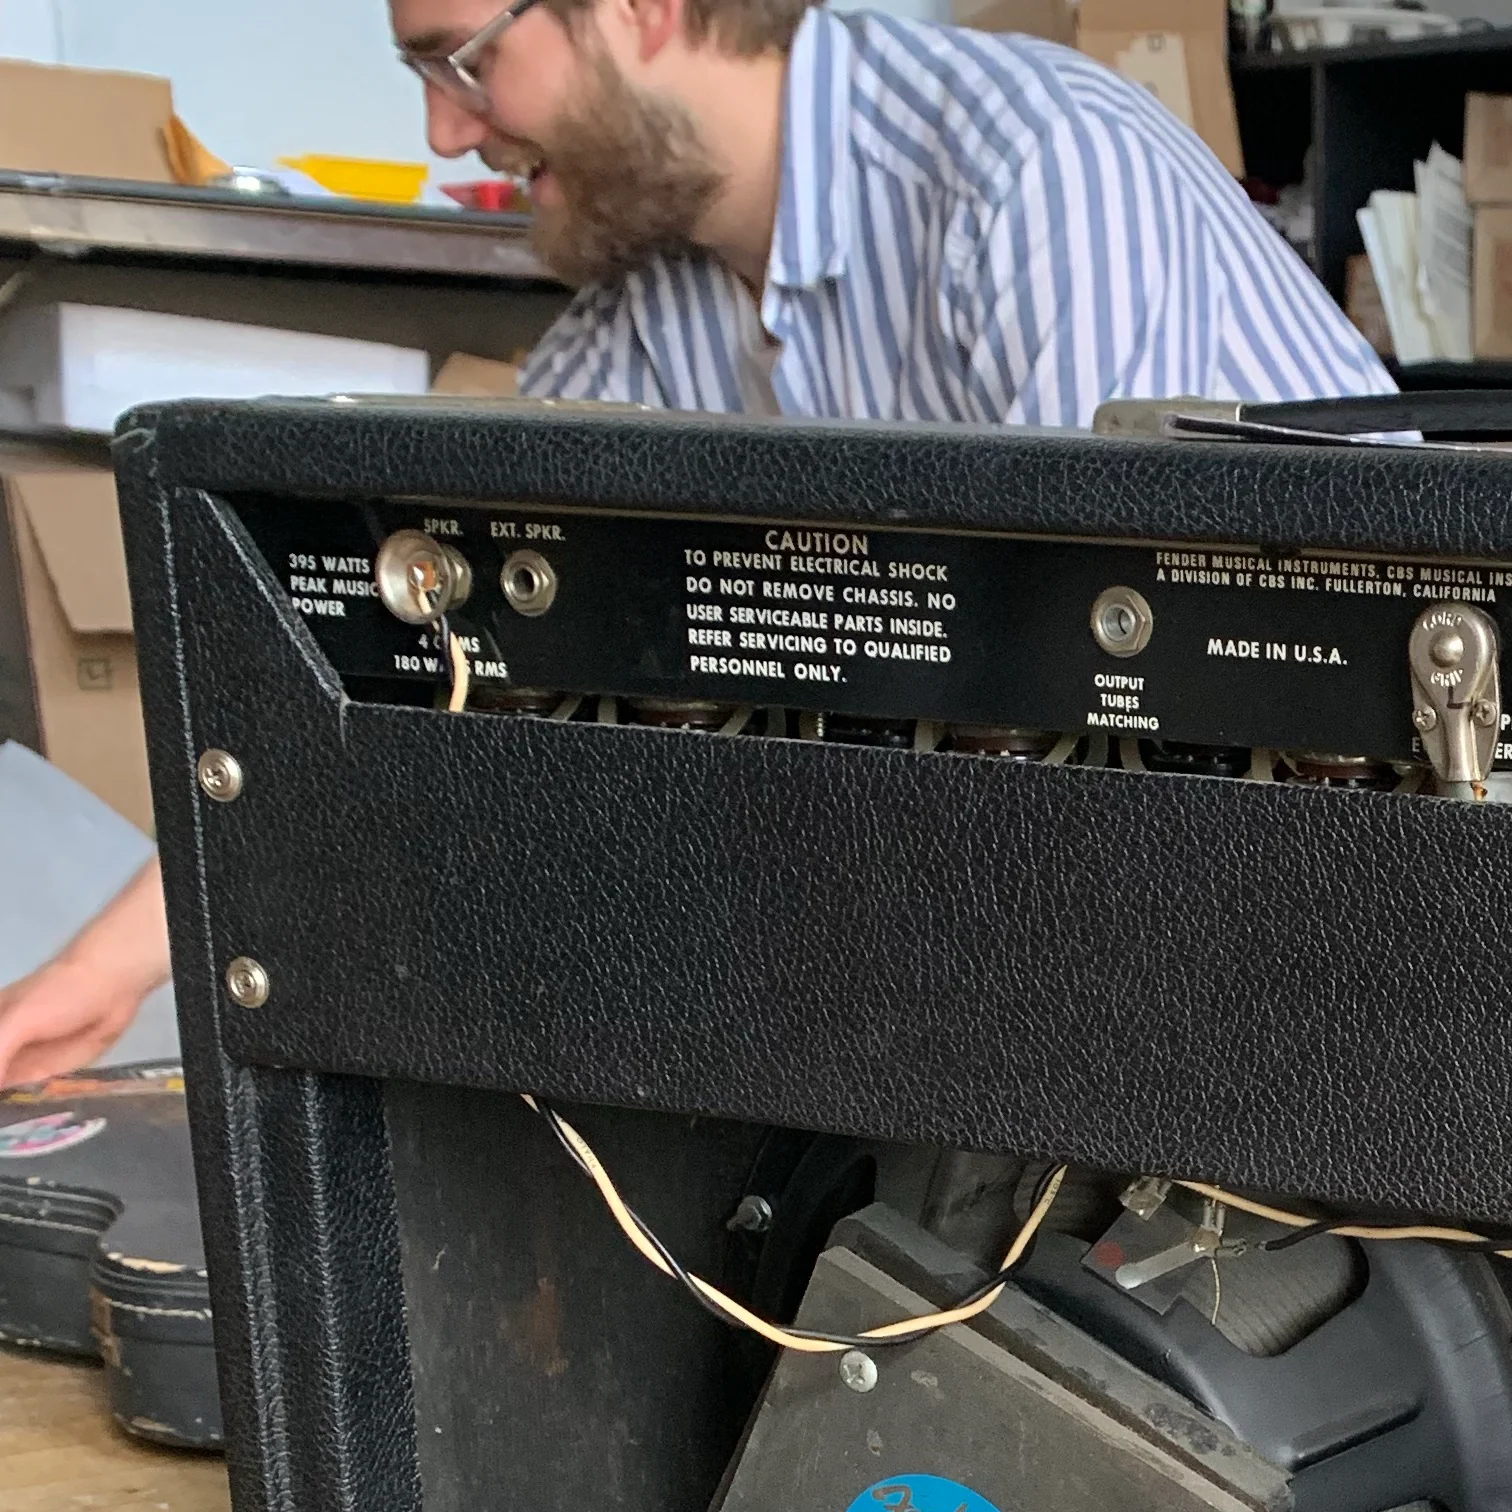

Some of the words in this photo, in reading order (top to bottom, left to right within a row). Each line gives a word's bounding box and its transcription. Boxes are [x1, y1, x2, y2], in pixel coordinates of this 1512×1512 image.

[424, 519, 464, 537] SPKR.
[491, 521, 521, 538] EXT.
[525, 523, 566, 542] SPKR.
[765, 530, 869, 556] CAUTION
[289, 554, 316, 570] 395
[321, 556, 370, 574] WATTS
[684, 549, 706, 566] TO
[714, 551, 782, 571] PREVENT
[790, 555, 880, 577] ELECTRICAL
[888, 562, 948, 582] SHOCK
[1156, 552, 1206, 568] FENDER
[1212, 554, 1272, 572] MUSICAL
[1386, 566, 1414, 581] CBS
[1420, 568, 1483, 585] MUSICAL
[290, 575, 328, 593] PEAK
[333, 579, 381, 597] MUSIC
[686, 576, 712, 594] DO
[720, 578, 754, 597] NOT
[763, 581, 834, 602] REMOVE
[842, 586, 918, 608] CHASSIS.
[928, 593, 956, 611] NO
[1156, 568, 1166, 582] A
[1171, 569, 1230, 586] DIVISION
[1236, 573, 1252, 587] OF
[1259, 575, 1285, 589] CBS
[1291, 576, 1318, 591] INC.
[1413, 583, 1496, 603] CALIFORNIA
[292, 597, 346, 617] POWER
[687, 603, 723, 621] USER
[729, 606, 828, 630] SERVICEABLE
[834, 613, 883, 633] PARTS
[890, 618, 948, 639] INSIDE.
[418, 633, 428, 650] 4
[688, 628, 732, 648] REFER
[739, 631, 827, 655] SERVICING
[834, 638, 857, 656] TO
[864, 640, 951, 663] QUALIFIED
[1207, 638, 1260, 659] MADE
[1266, 642, 1287, 661] IN
[1294, 645, 1348, 666] U.S.A.
[393, 654, 420, 672] 180
[474, 660, 508, 679] RMS
[690, 655, 785, 679] PERSONNEL
[794, 662, 848, 683] ONLY.
[1094, 673, 1145, 691] OUTPUT
[1100, 693, 1139, 710] TUBES
[1087, 712, 1159, 731] MATCHING
